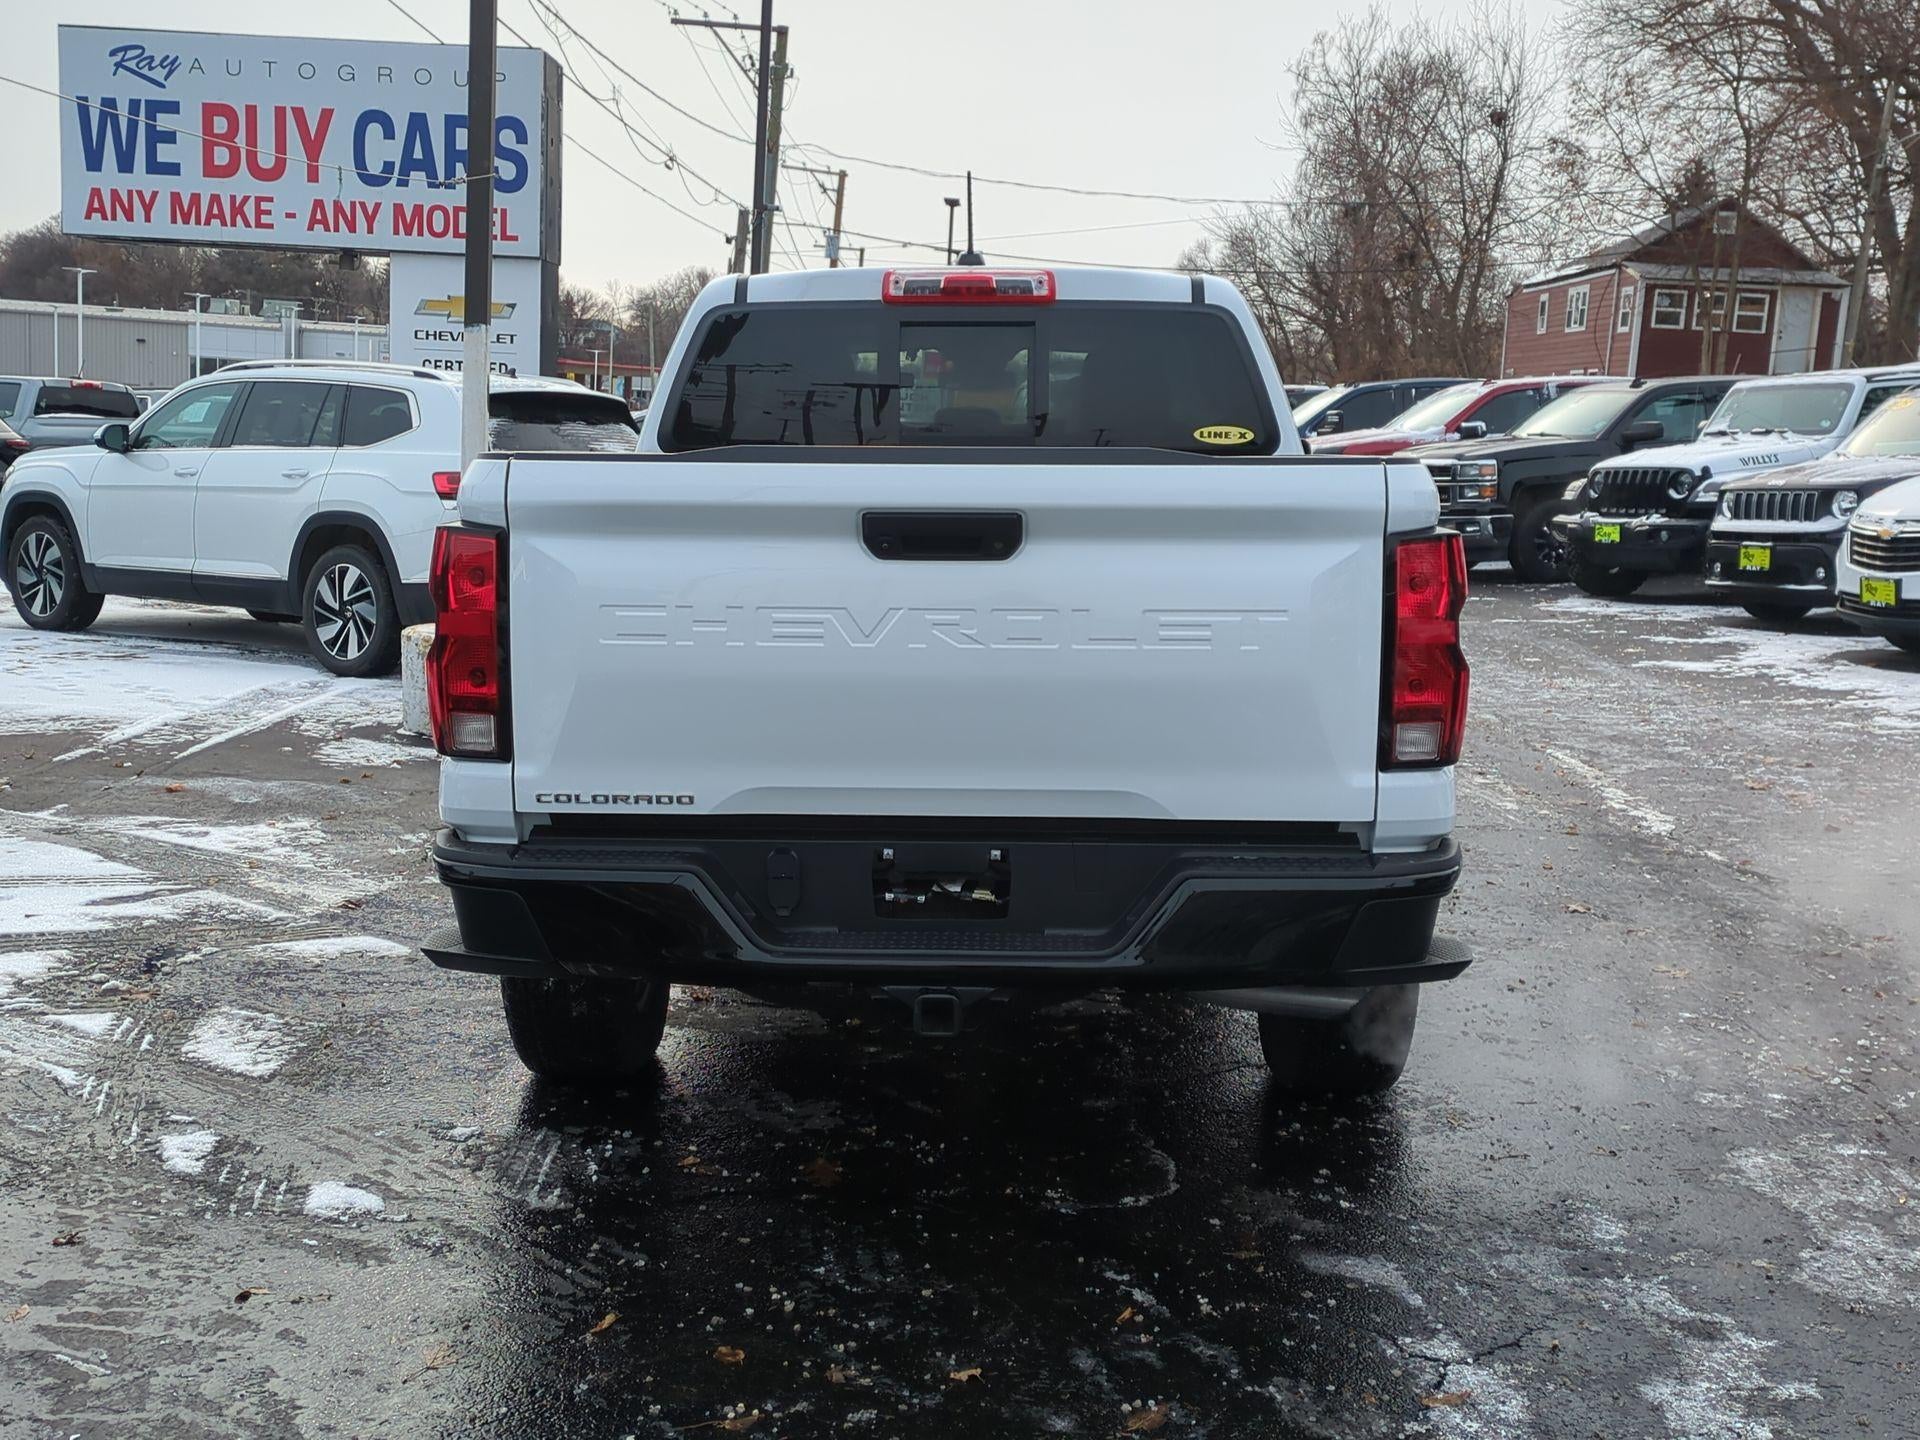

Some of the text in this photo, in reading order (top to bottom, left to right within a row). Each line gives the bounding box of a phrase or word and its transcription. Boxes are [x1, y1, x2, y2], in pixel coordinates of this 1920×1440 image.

[108, 44, 181, 89] Ray
[75, 95, 529, 194] WE BUY CARS
[84, 187, 160, 224] ANY
[170, 191, 275, 230] MAKE
[306, 198, 382, 235] ANY
[414, 329, 518, 345] CHEVET
[422, 359, 509, 374] CERTED
[1199, 430, 1249, 440] LINE-X
[1738, 453, 1780, 467] WILLYS
[599, 604, 1289, 650] CHEVROLET
[535, 793, 695, 805] COLORADO
